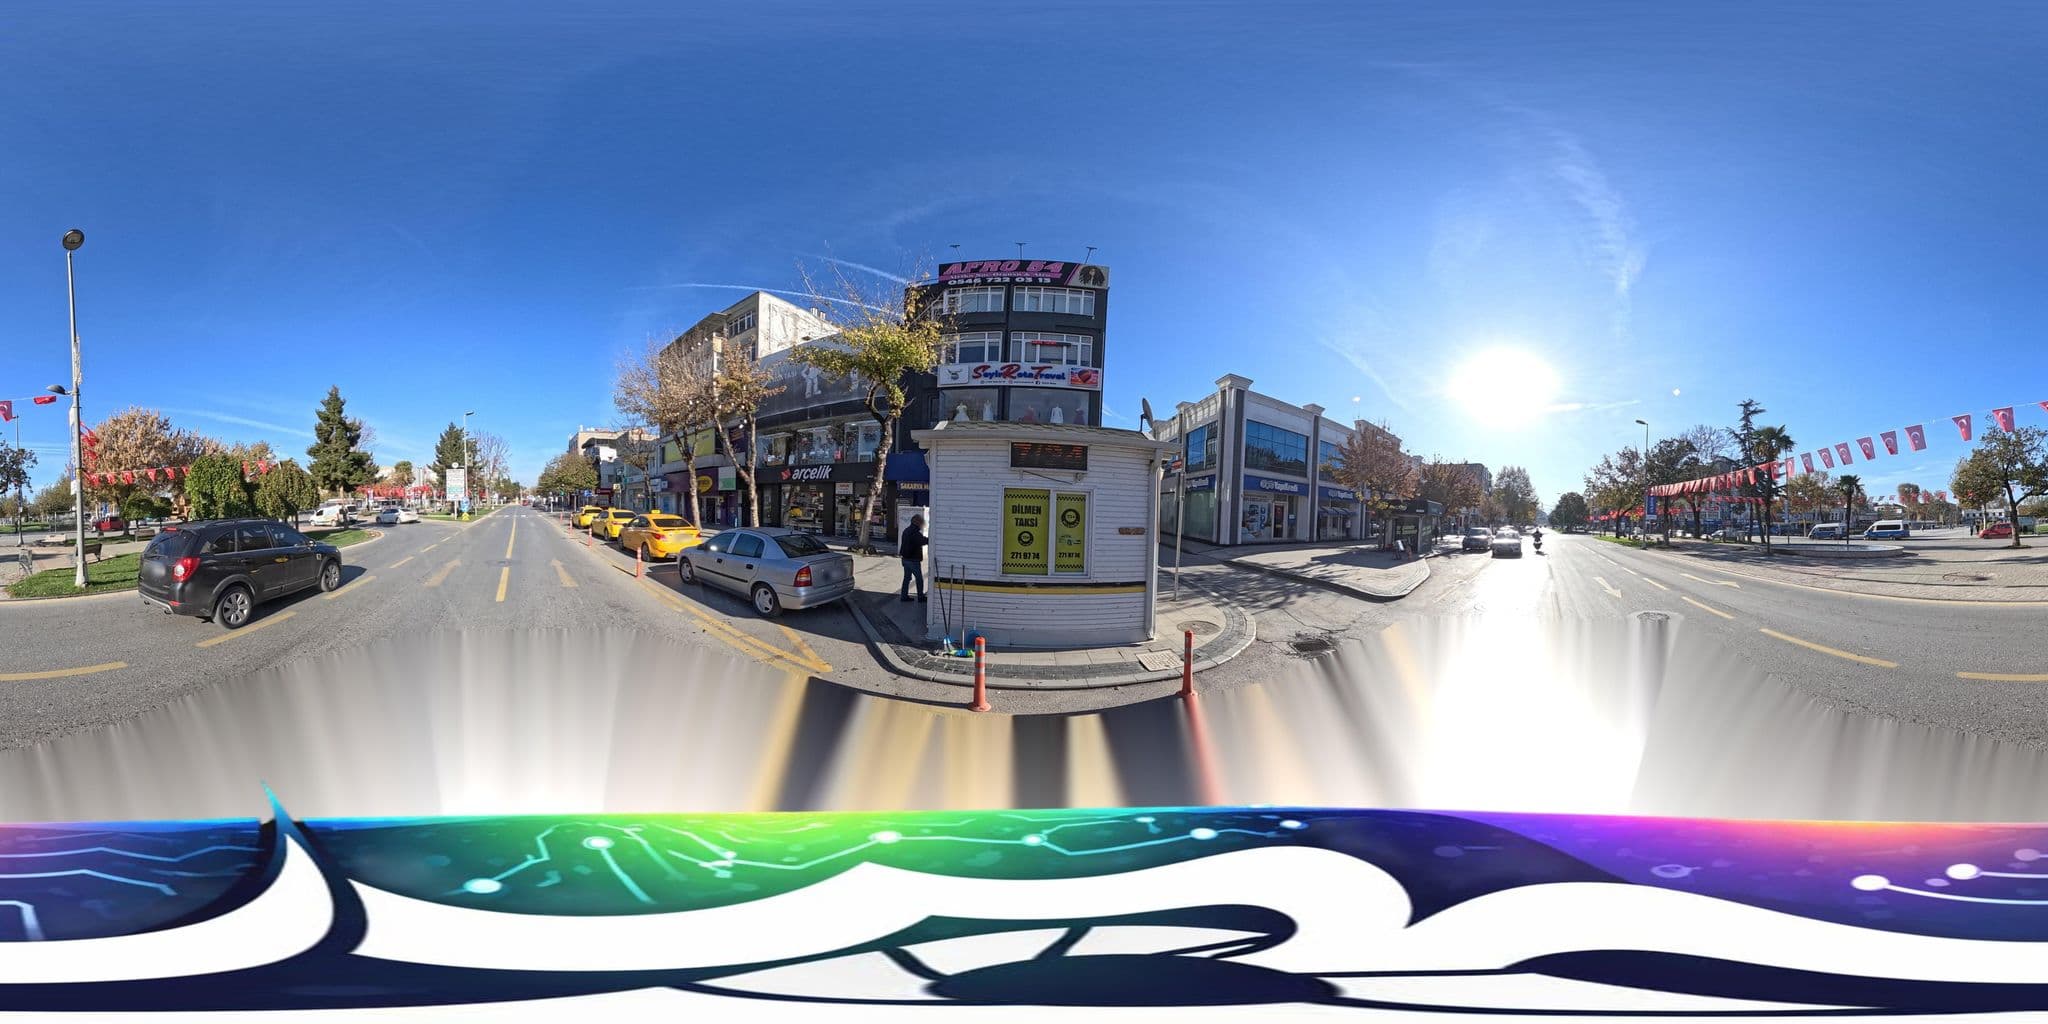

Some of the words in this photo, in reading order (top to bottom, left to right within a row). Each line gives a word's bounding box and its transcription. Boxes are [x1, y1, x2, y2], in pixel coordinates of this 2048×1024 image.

[943, 261, 1020, 275] AFRO
[1026, 261, 1065, 273] 54
[792, 465, 832, 482] arçelik
[1012, 504, 1041, 515] DİLMEN
[1014, 517, 1038, 527] TAKSİ
[1010, 552, 1022, 560] 271
